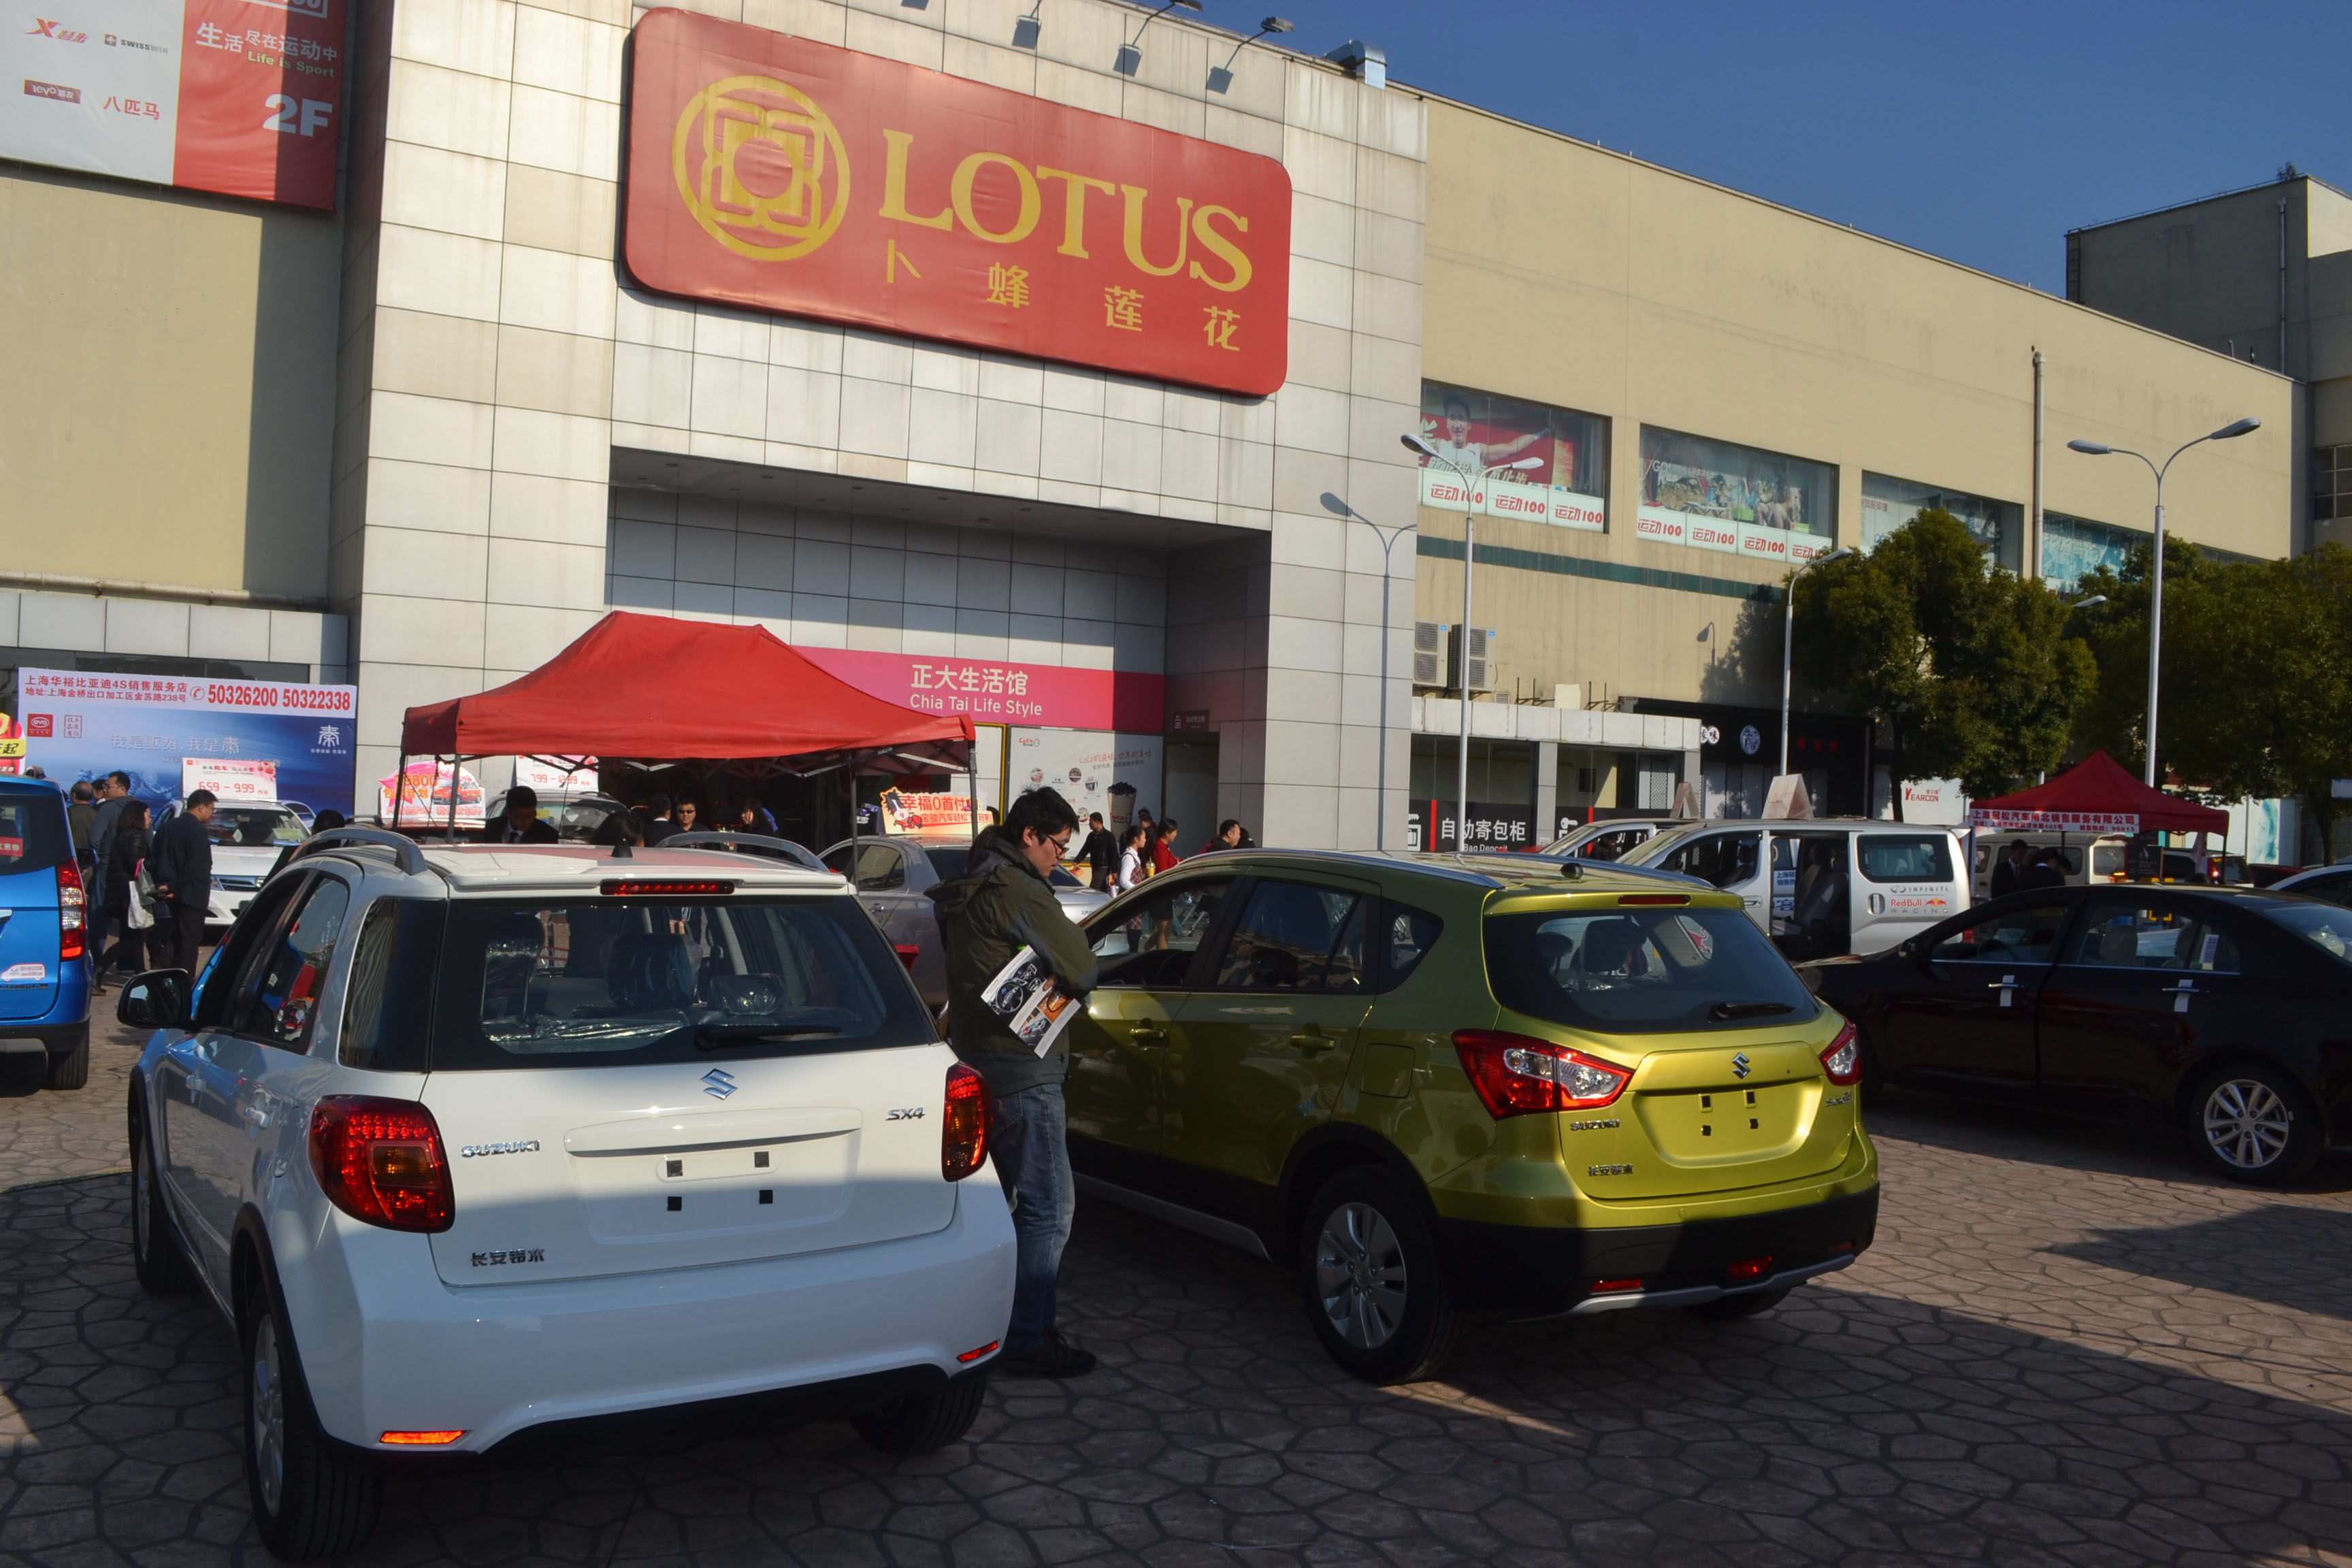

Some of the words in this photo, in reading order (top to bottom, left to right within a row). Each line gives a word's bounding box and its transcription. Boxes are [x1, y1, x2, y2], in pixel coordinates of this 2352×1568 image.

[120, 39, 168, 54] SWISSWIN
[196, 22, 338, 61] 生活尽在运动中
[247, 50, 275, 65] Life
[279, 57, 291, 68] is
[296, 61, 335, 78] Sport
[103, 96, 160, 120] 八匹马
[263, 94, 333, 137] 2F
[879, 129, 1253, 293] LOTUS
[885, 240, 1241, 353] 卜蜂莲花
[1496, 494, 1546, 514] 运动100
[1555, 504, 1603, 524] 运动100
[1637, 519, 1682, 536] 运动100
[1693, 527, 1735, 545] 运动100
[1744, 536, 1785, 553] 运动100
[25, 675, 187, 693] 上海华裕比亚迪4S销售服务店
[911, 664, 1028, 696] 正大生活馆
[208, 684, 278, 706] 50326200
[282, 688, 350, 710] 50322338
[910, 693, 943, 709] Chia
[948, 696, 969, 711] Tai
[974, 698, 1001, 713] Life
[1006, 700, 1042, 718] Style
[318, 724, 340, 748] 秦
[0, 742, 19, 754] 起
[901, 795, 979, 811] 幸福0首付
[1905, 787, 1939, 802] YEARCON
[1891, 898, 1906, 906] Red
[1907, 898, 1923, 906] Bull
[885, 1107, 926, 1122] SX4
[1569, 1119, 1620, 1131] SUZUKI
[461, 1139, 541, 1158] SUZUKI
